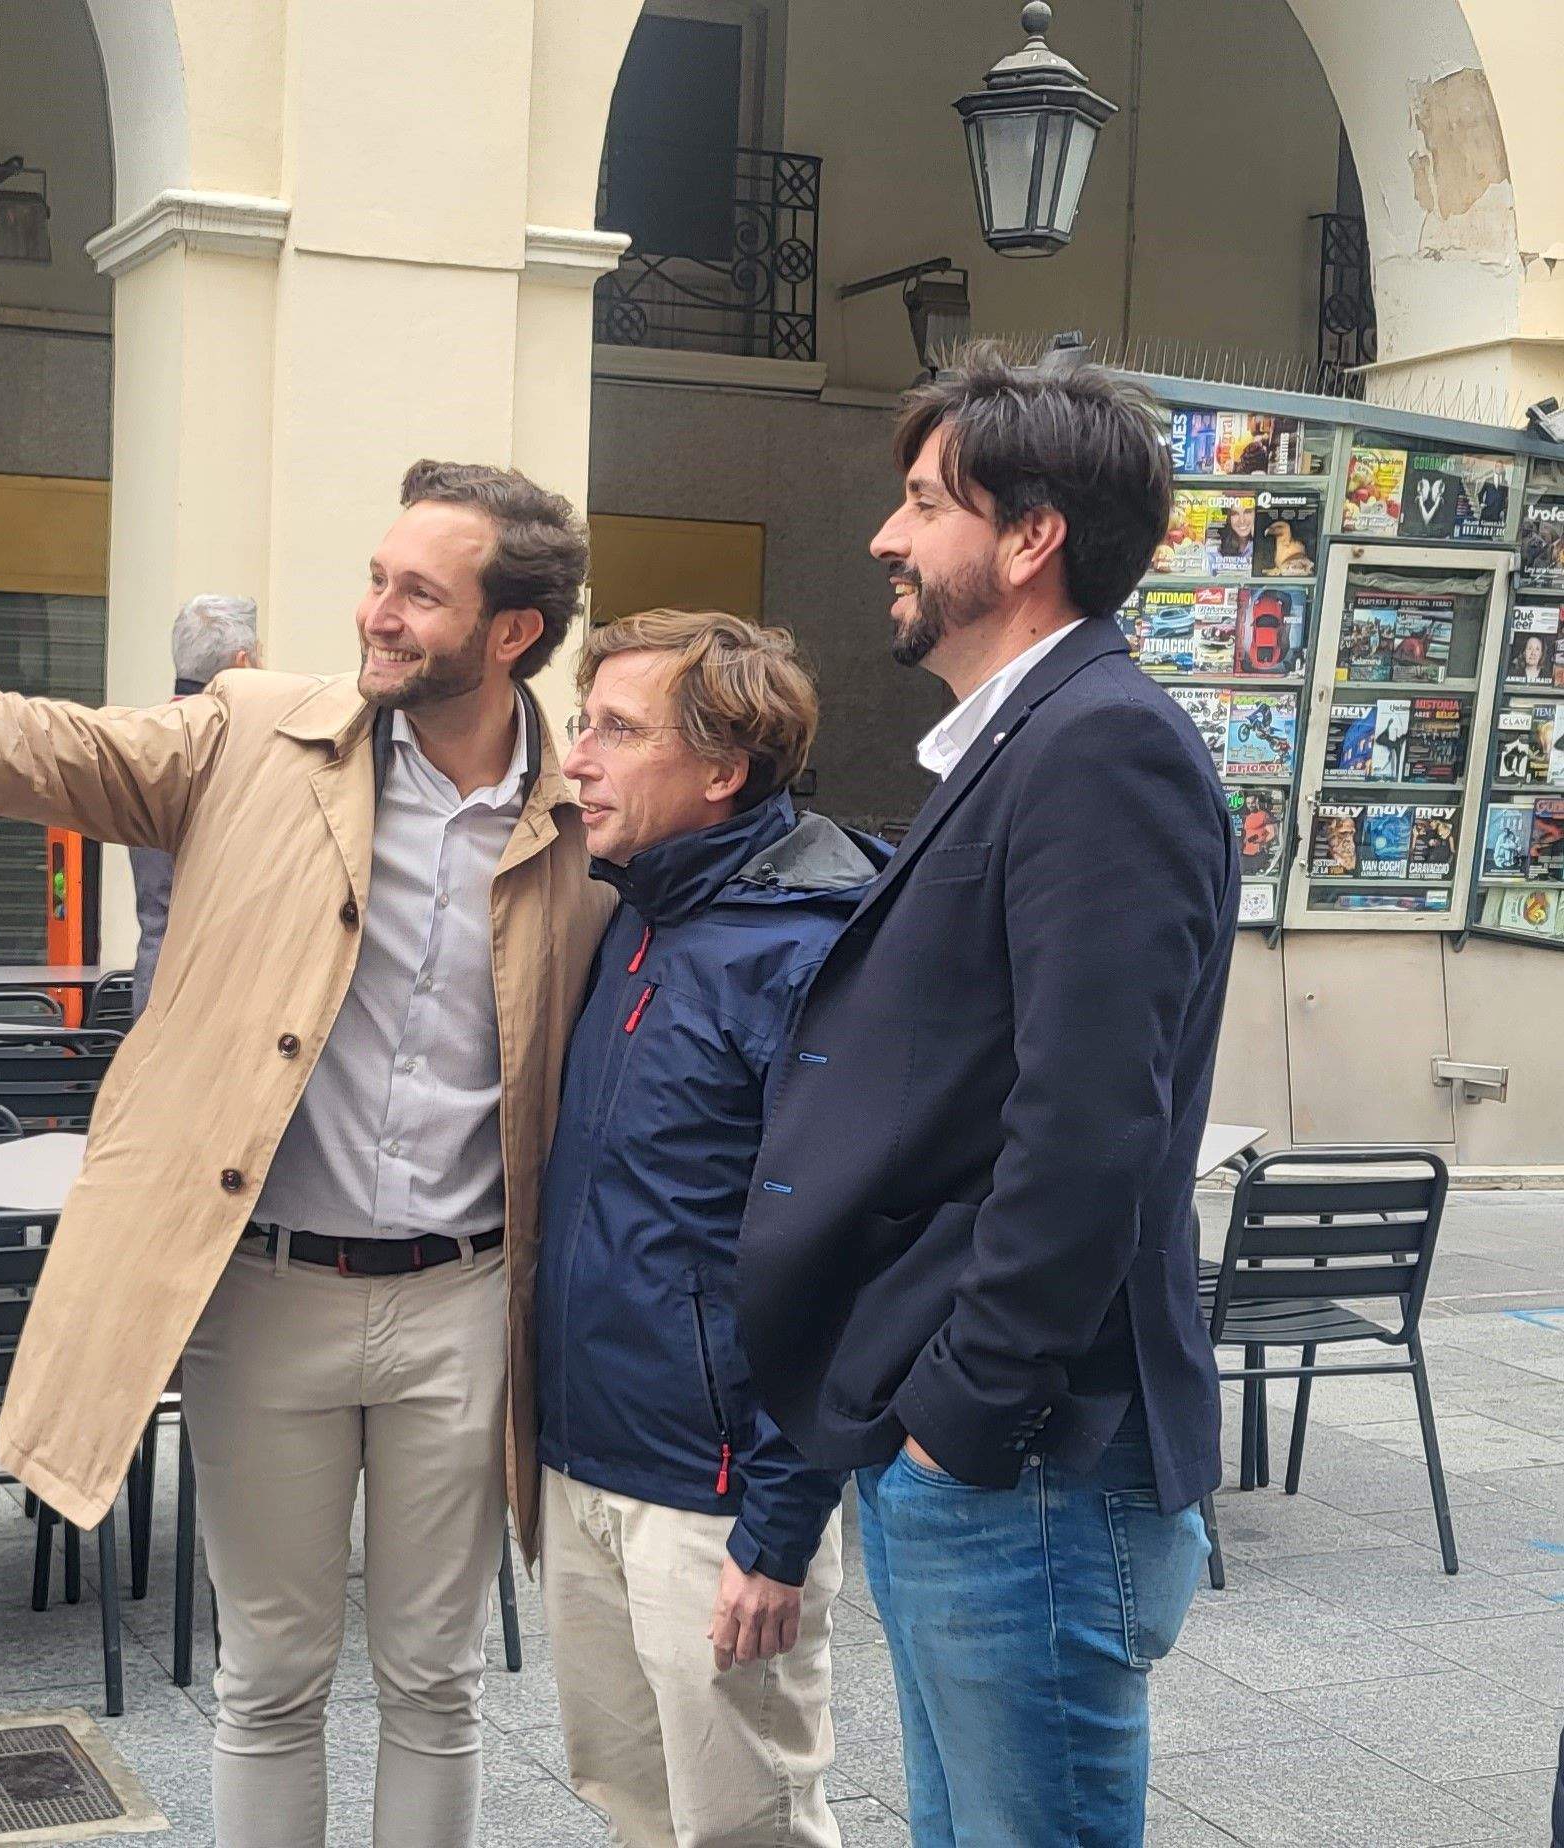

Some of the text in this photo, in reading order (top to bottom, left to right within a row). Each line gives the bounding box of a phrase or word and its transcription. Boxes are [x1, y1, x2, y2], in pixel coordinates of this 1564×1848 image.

[1257, 491, 1307, 508] Quercus
[1331, 706, 1373, 718] muy
[1319, 806, 1363, 818] muy
[1367, 805, 1409, 817] muy
[1415, 807, 1456, 819] muy
[1362, 860, 1400, 872] VAN GOGH
[1409, 862, 1450, 874] CARAVAGGIO
